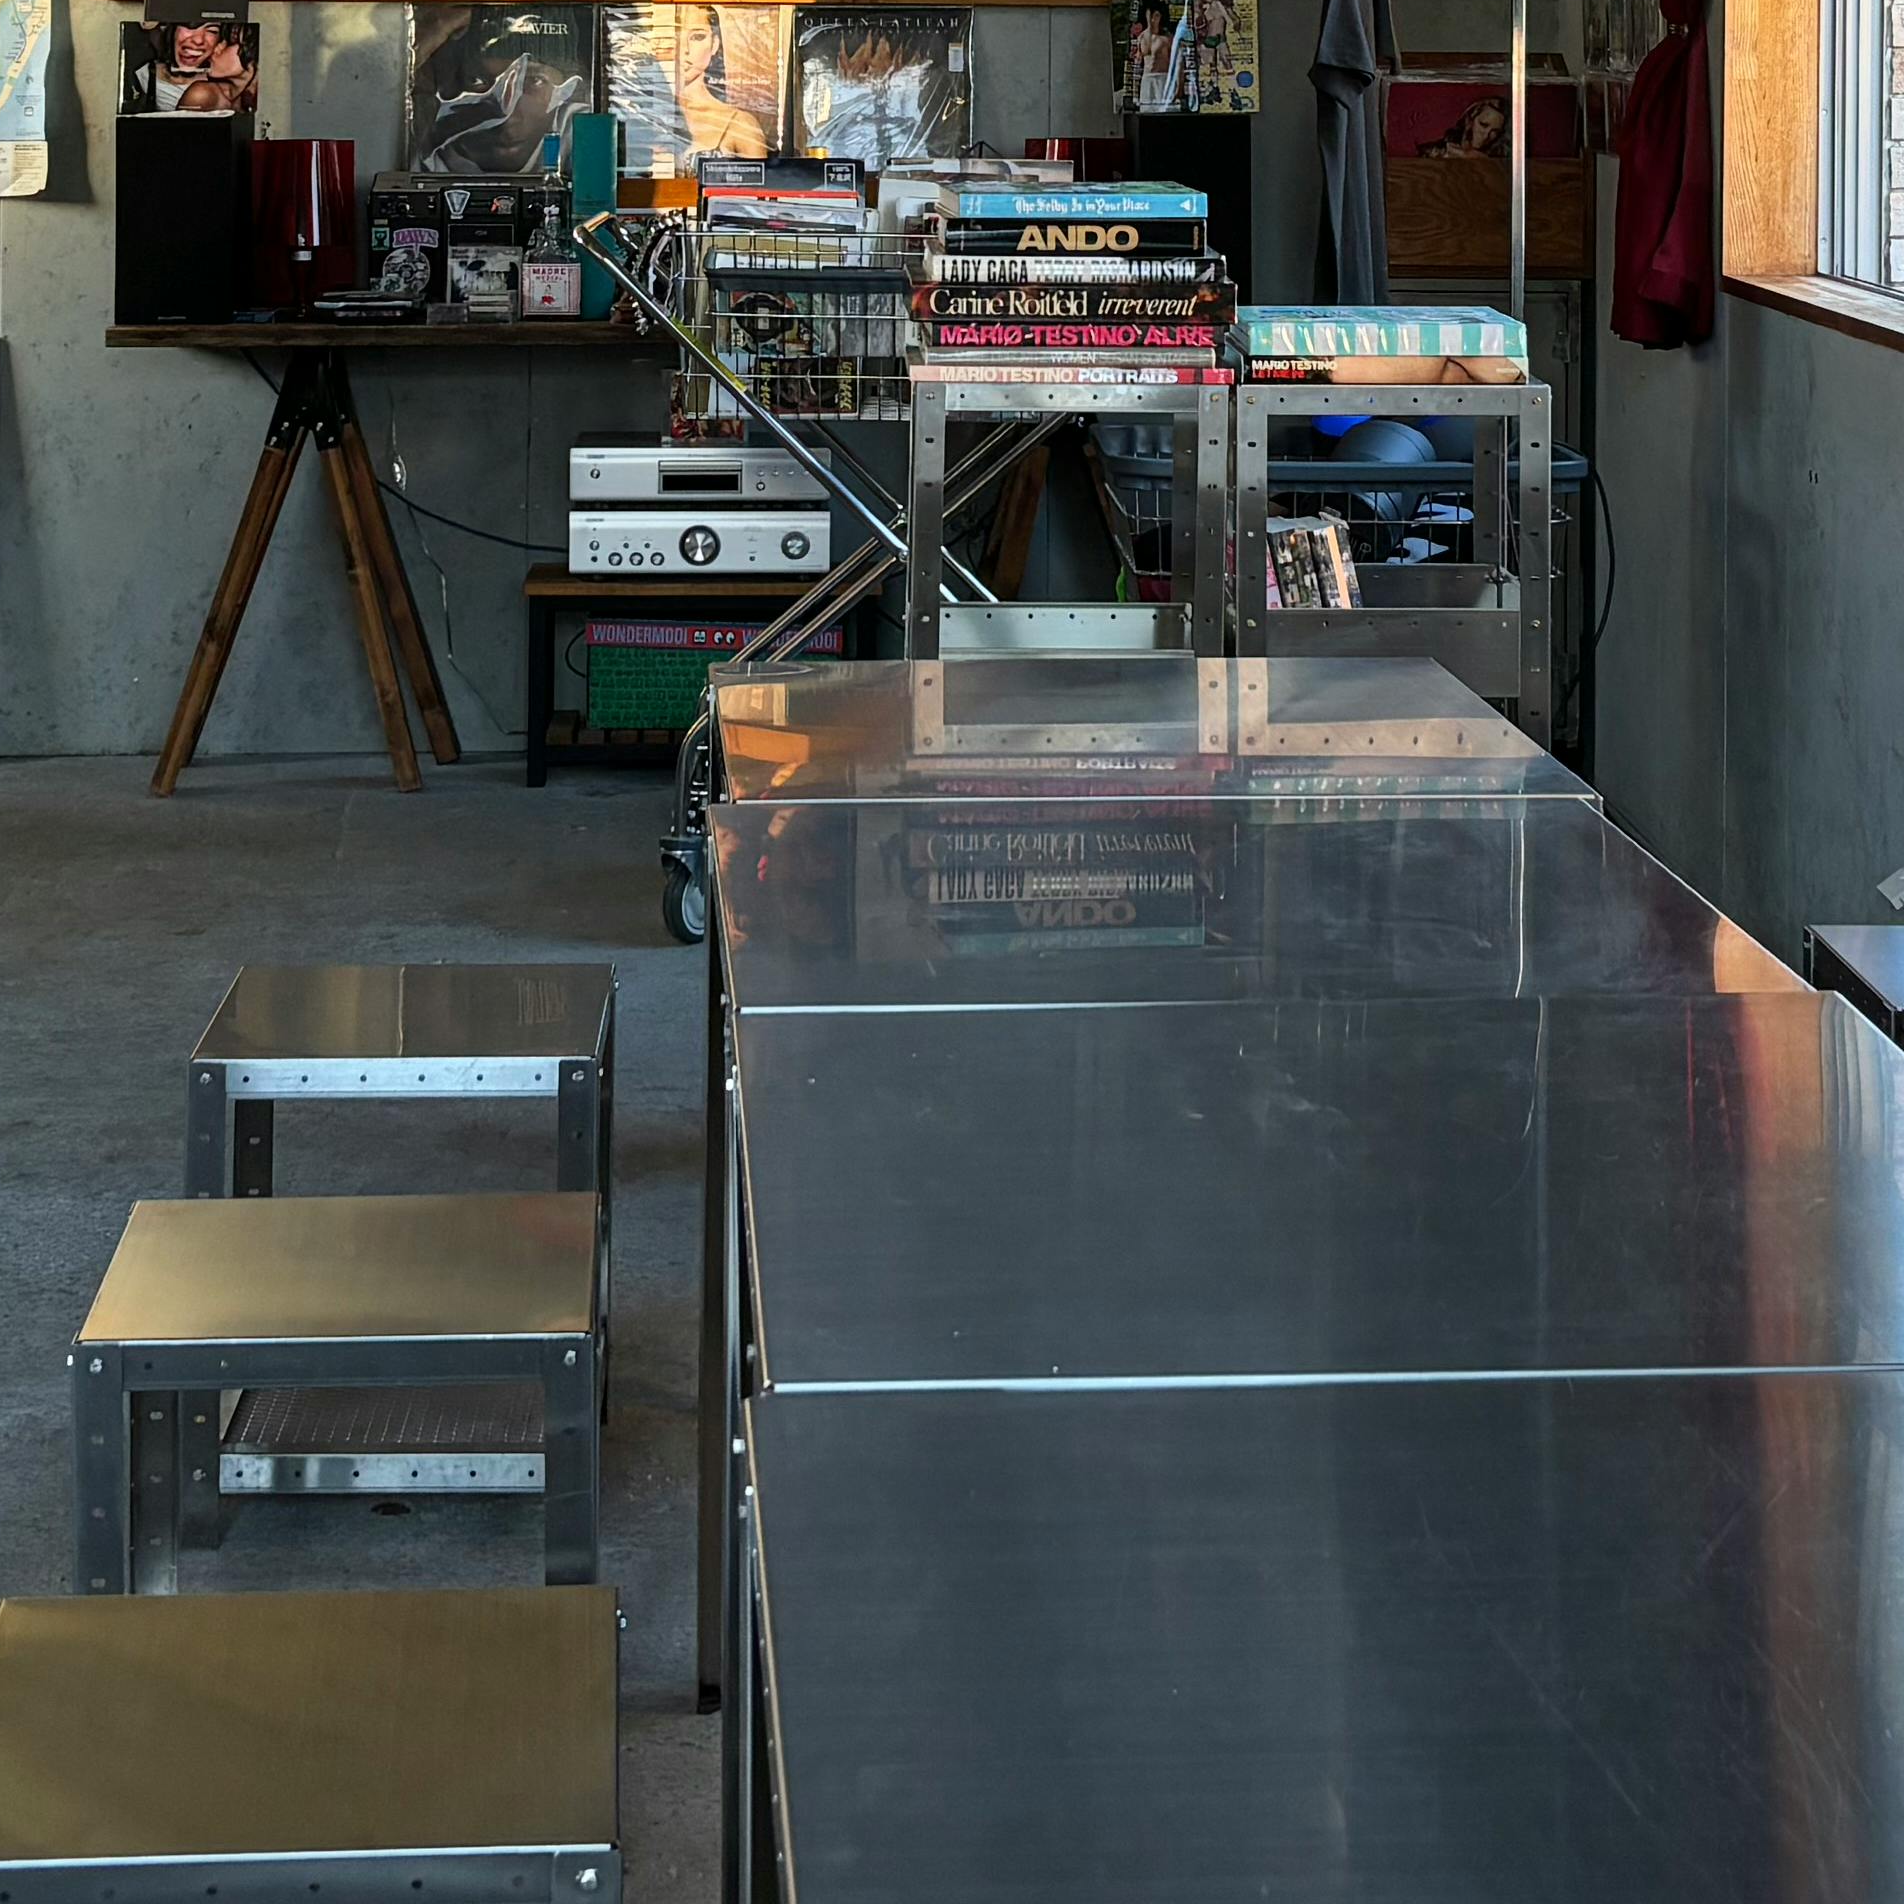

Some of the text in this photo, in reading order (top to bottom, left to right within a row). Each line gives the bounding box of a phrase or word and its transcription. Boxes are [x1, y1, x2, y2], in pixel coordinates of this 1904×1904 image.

[523, 22, 569, 35] AVIER
[1015, 224, 1140, 251] ANDO
[532, 268, 567, 276] MADRE
[941, 260, 981, 283] LADY
[987, 260, 1029, 283] GAGA
[928, 287, 1200, 317] Carine Roitfeld irreverent
[1251, 359, 1337, 371] MARIO TESTINO
[939, 367, 1178, 384] MARIO TESTINO PORTRAITS
[592, 624, 688, 644] WONDERMOOI
